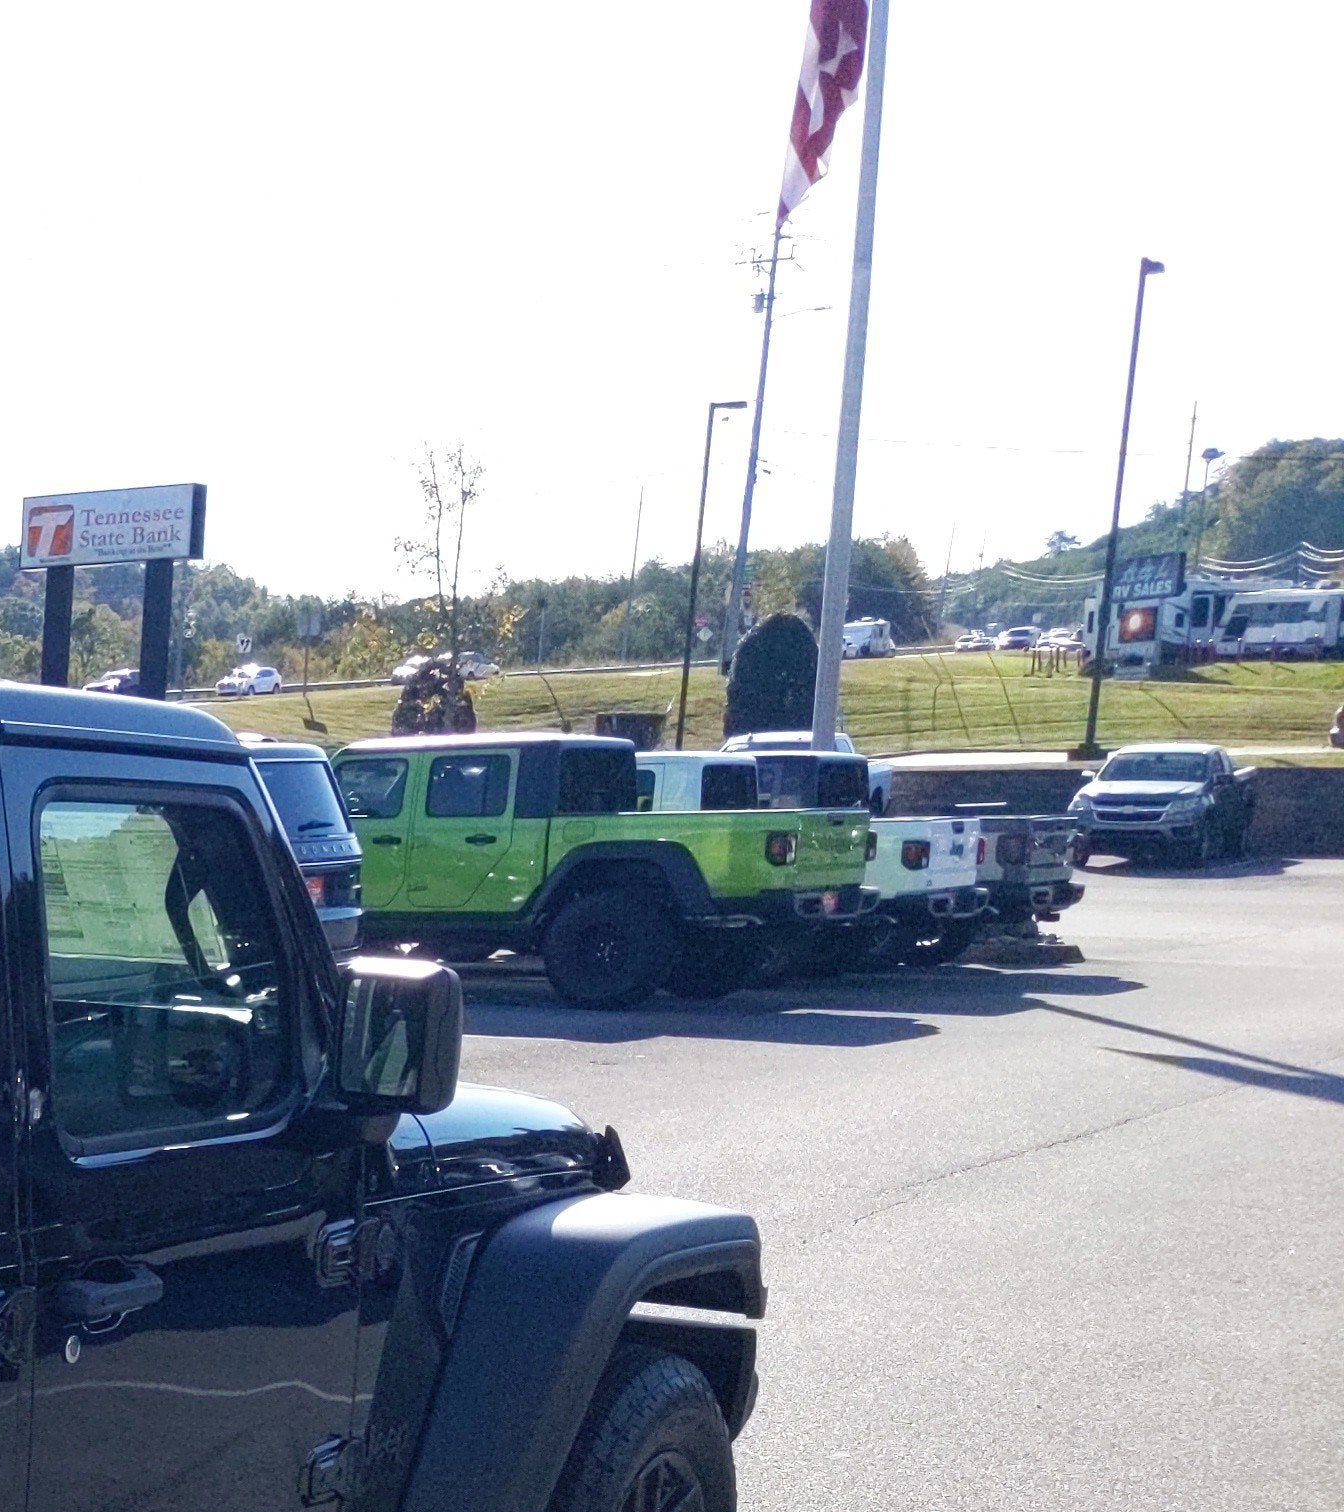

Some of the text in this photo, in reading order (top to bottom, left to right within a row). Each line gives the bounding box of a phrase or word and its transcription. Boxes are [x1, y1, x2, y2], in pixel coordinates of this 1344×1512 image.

[80, 507, 184, 526] Tennessee
[79, 524, 181, 548] State Bank
[1112, 579, 1172, 599] RV SALES
